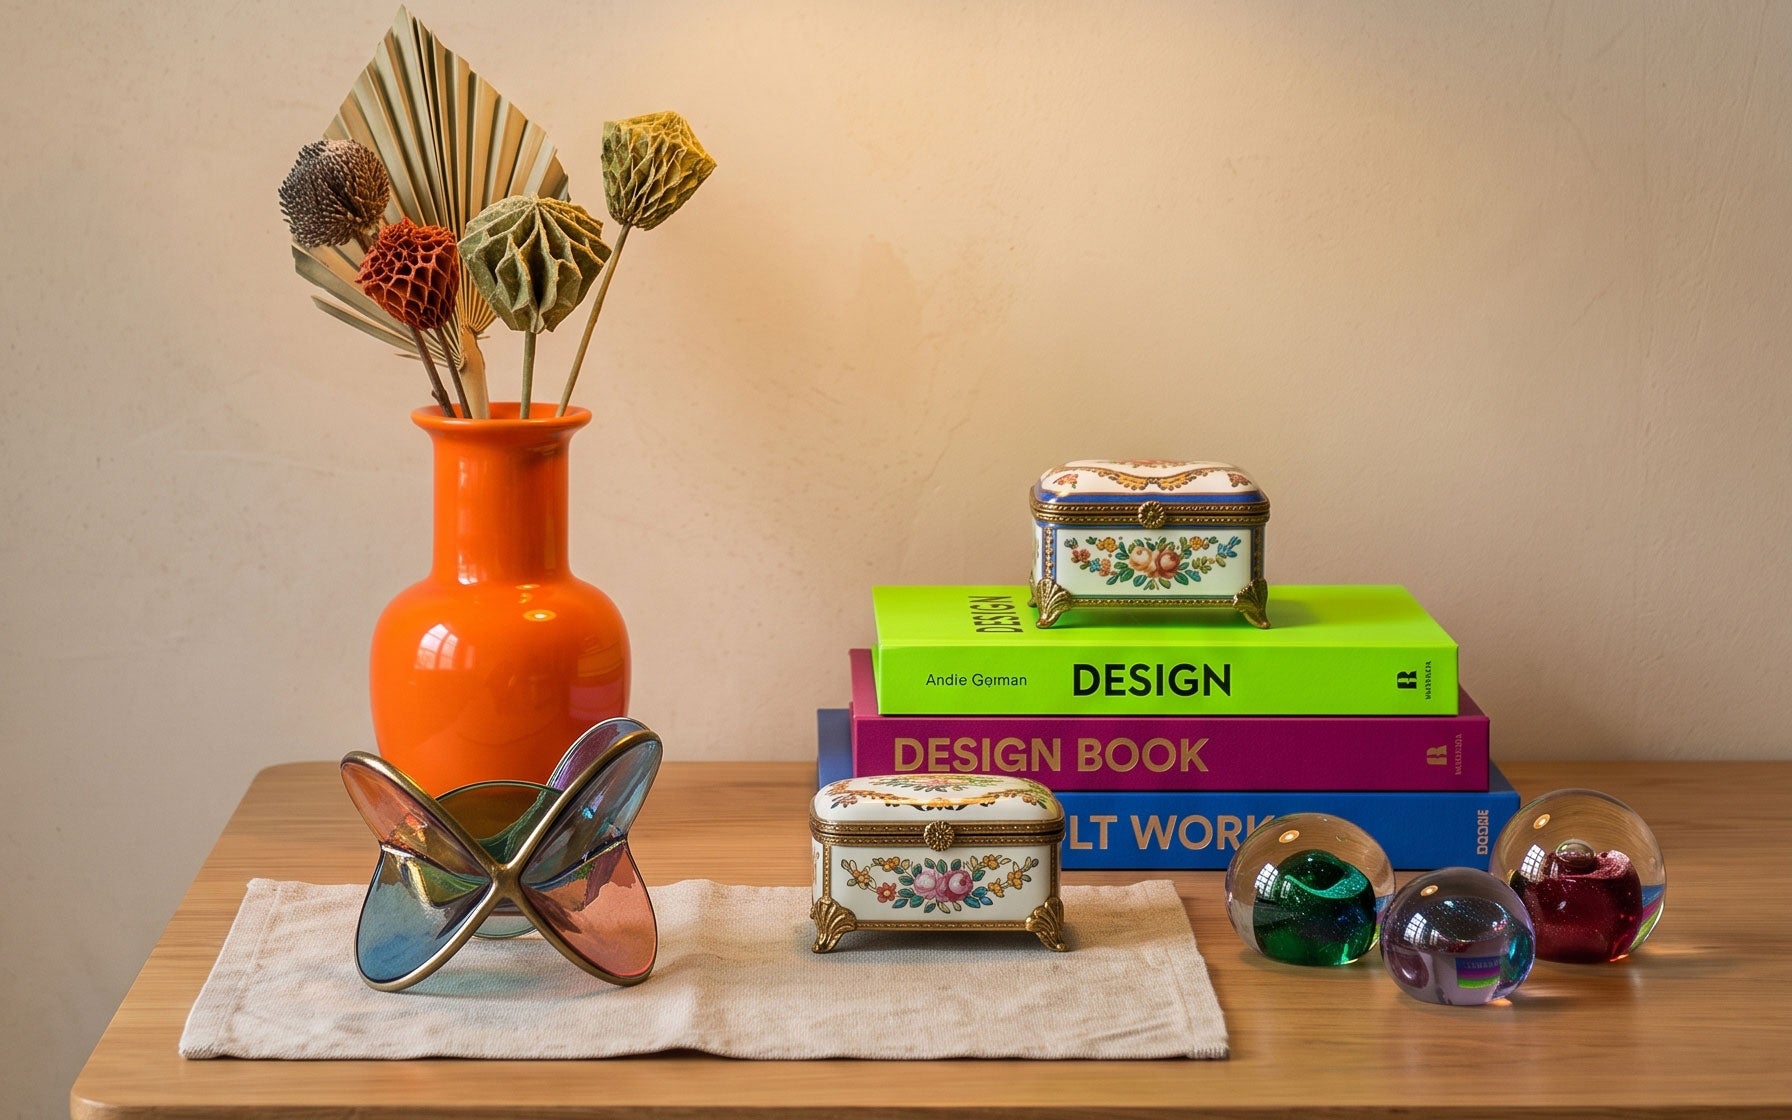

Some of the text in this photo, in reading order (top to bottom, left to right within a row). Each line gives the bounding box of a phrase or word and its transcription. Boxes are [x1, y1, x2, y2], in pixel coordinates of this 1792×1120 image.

[968, 595, 1024, 633] DESIGN
[925, 673, 968, 686] Andie
[1073, 663, 1232, 697] DESIGN
[894, 737, 1210, 773] DESIGN BOOK
